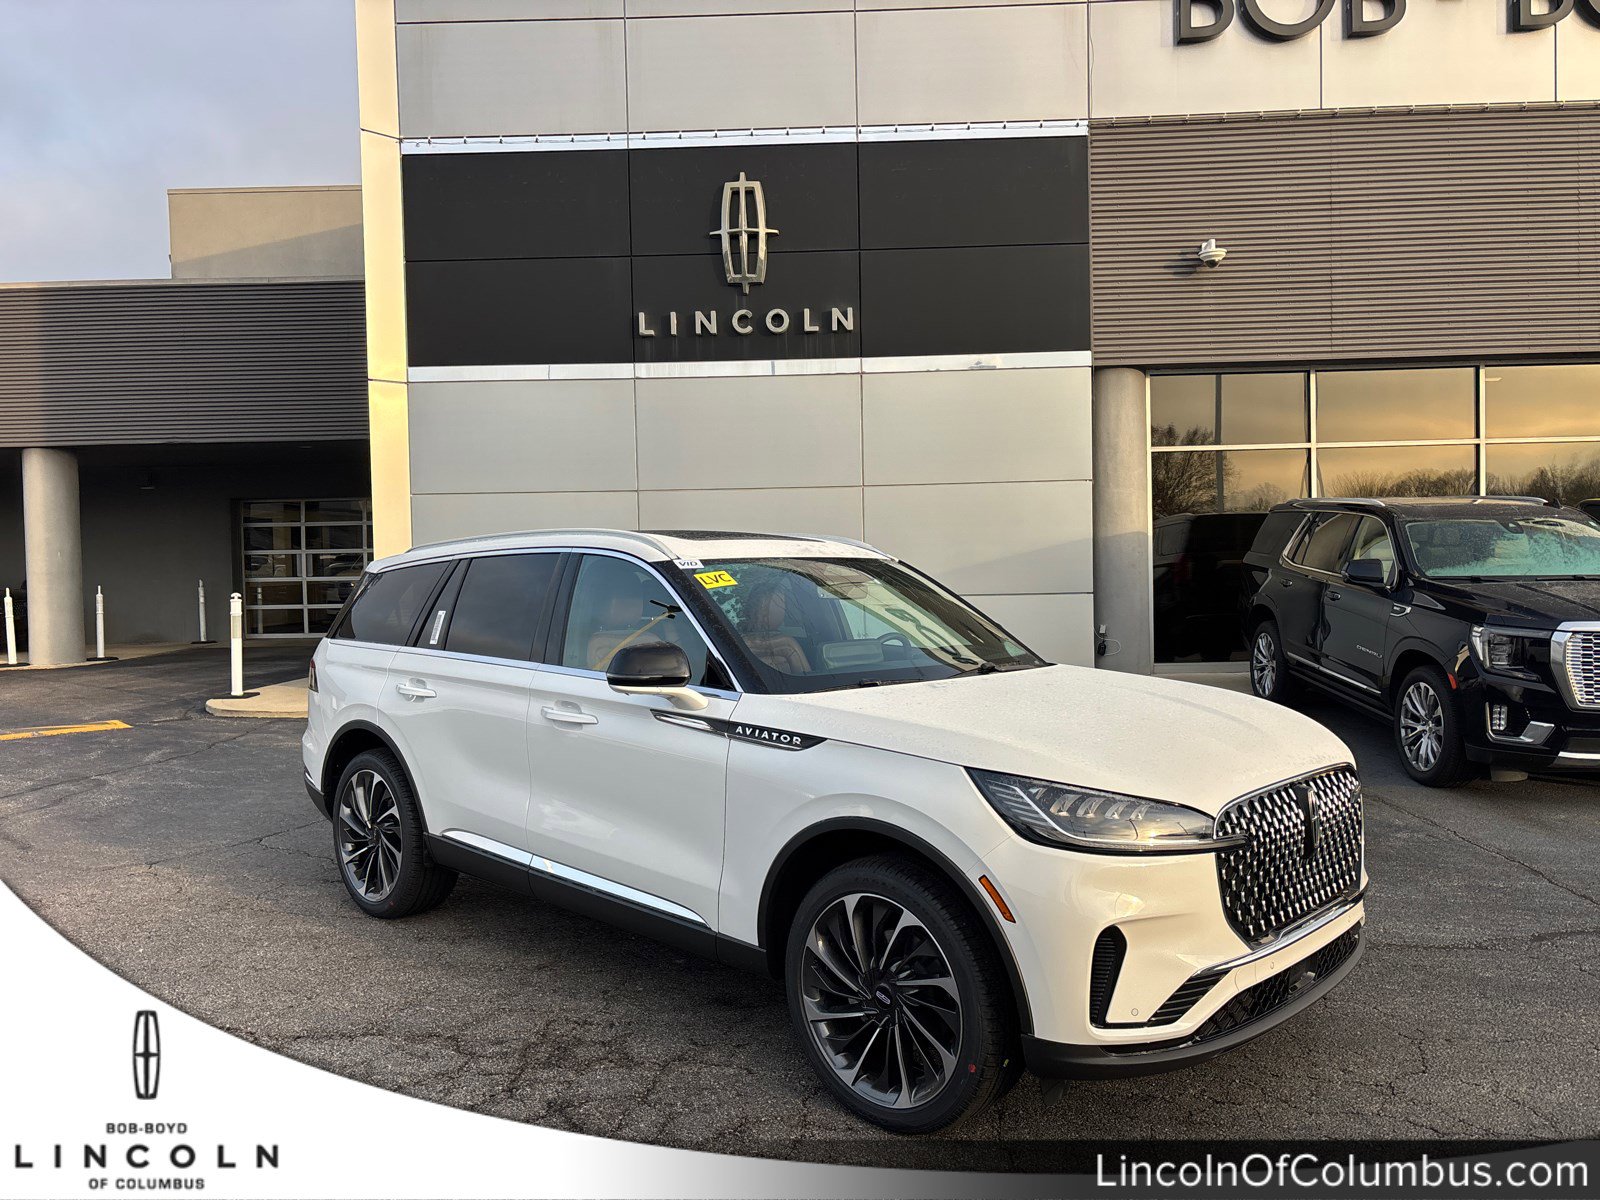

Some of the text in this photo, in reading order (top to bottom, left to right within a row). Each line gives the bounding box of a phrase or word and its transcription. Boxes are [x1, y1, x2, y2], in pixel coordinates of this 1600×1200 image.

[638, 307, 854, 336] LINCOLN
[699, 573, 732, 585] LVC
[735, 725, 802, 745] AVIATOR
